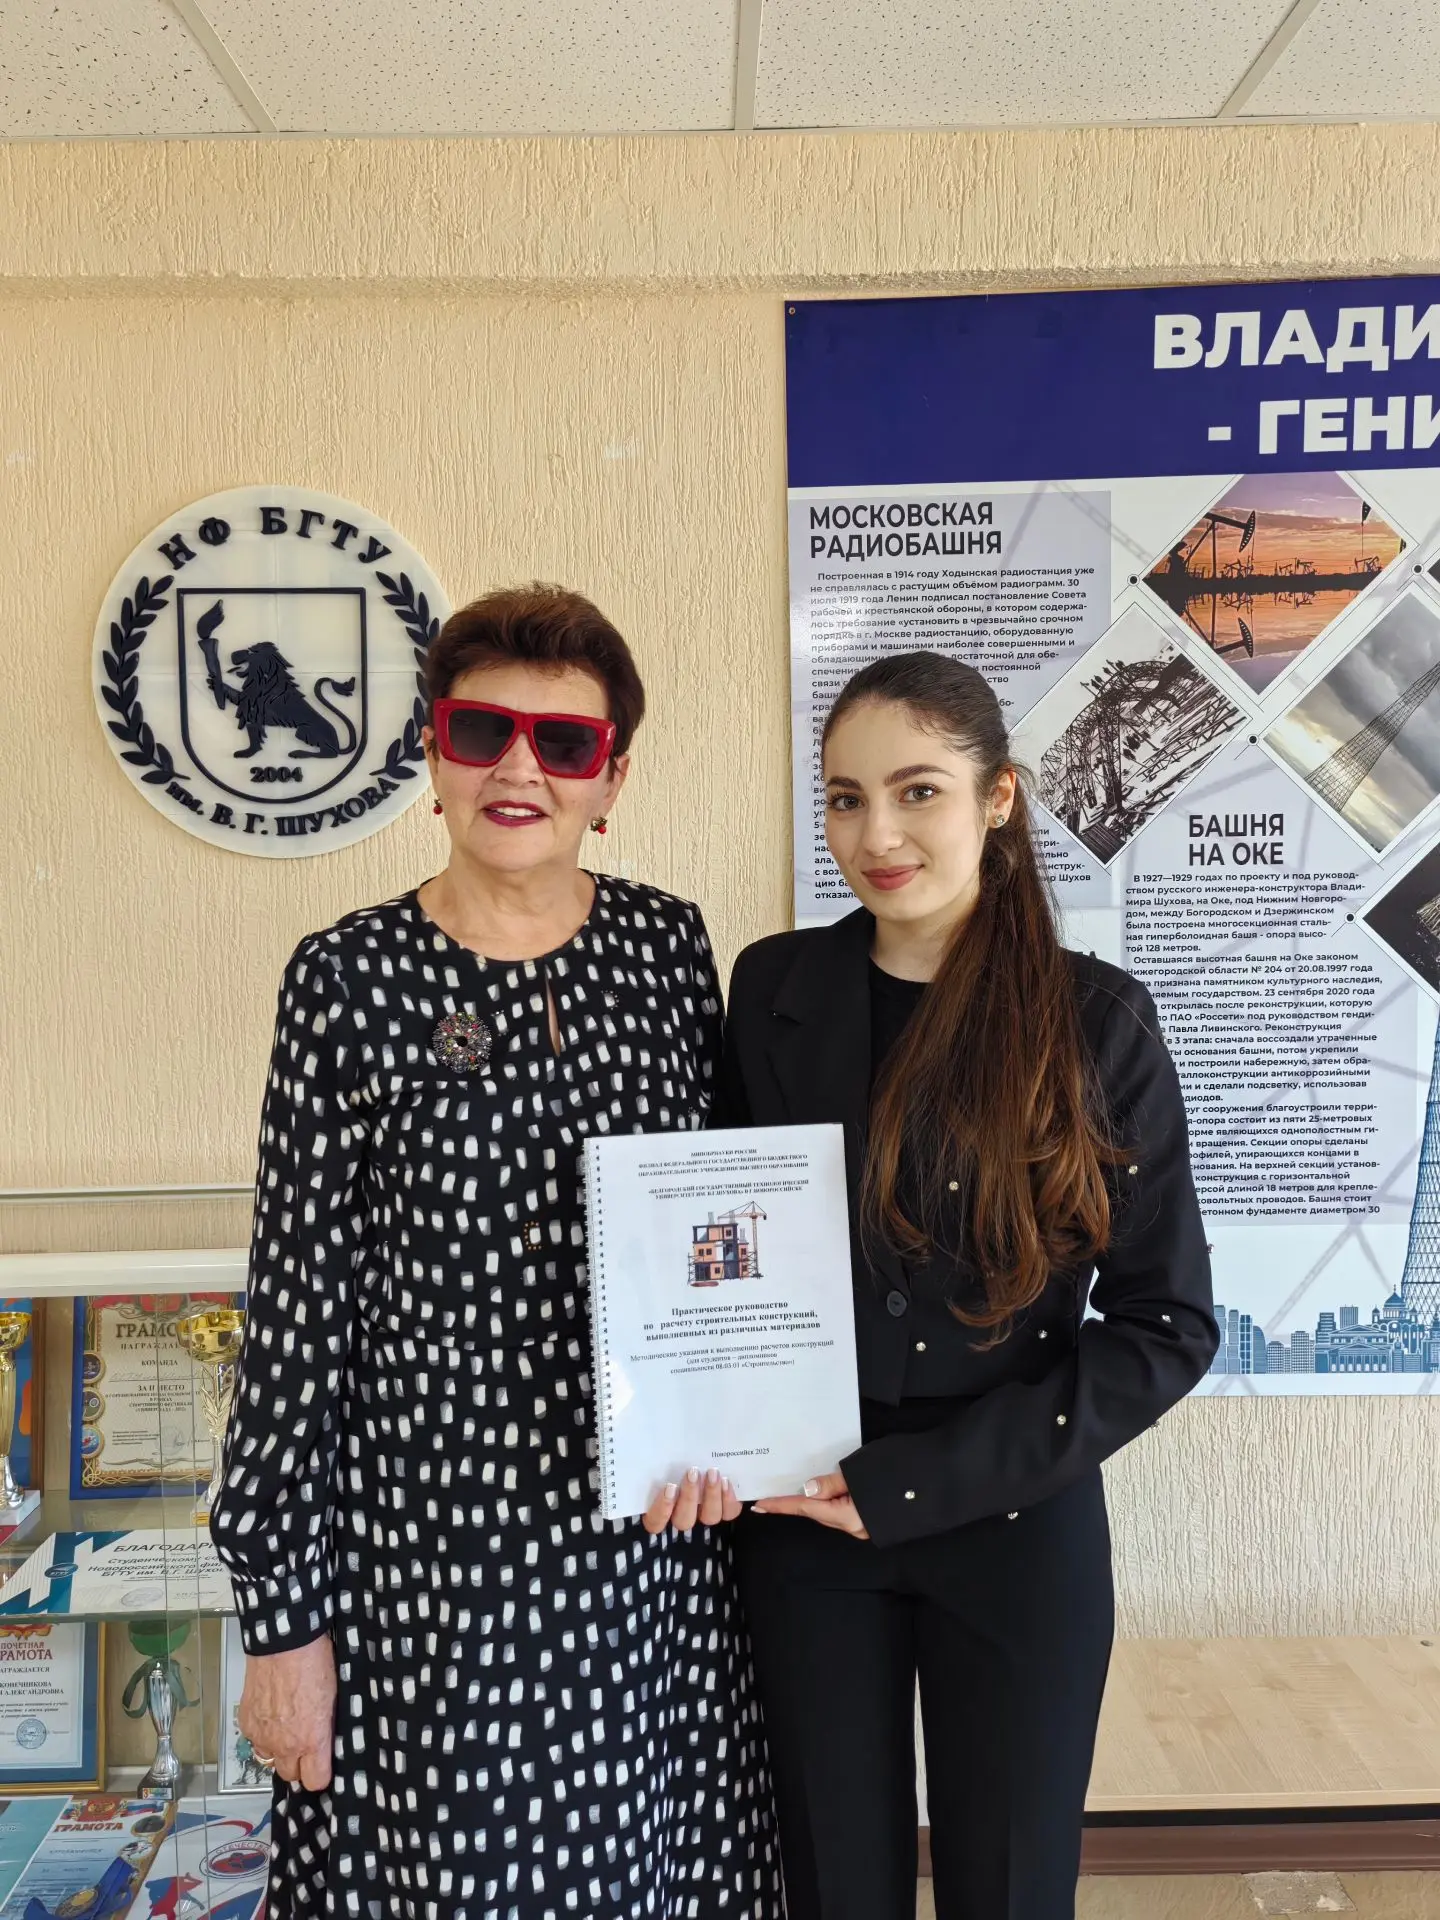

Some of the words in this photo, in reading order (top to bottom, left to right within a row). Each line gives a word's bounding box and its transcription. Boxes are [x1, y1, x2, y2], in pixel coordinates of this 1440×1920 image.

[1154, 304, 1440, 373] ВЛАДИ
[810, 502, 993, 530] МОСКОВСКАЯ
[158, 517, 231, 570] НФ
[260, 507, 392, 564] БГТУ
[811, 531, 1002, 562] РАДИОБАШНЯ
[818, 570, 883, 582] Построенная
[894, 570, 914, 578] 1914
[916, 571, 939, 579] году
[942, 568, 997, 578] Ходынская
[1000, 568, 1072, 577] радиостанция
[1074, 567, 1094, 576] уже
[824, 584, 889, 593] справлялась
[899, 582, 949, 592] растущим
[952, 579, 997, 588] объёмом
[1000, 580, 1064, 589] радиограмм.
[838, 594, 858, 603] 1919
[886, 593, 918, 602] Ленин
[921, 594, 969, 602] подписал
[1051, 590, 1086, 598] Совета
[811, 642, 868, 653] приборами
[937, 639, 984, 648] наиболее
[987, 639, 1065, 649] совершенными
[250, 766, 302, 783] 2004
[166, 782, 204, 816] им.
[210, 803, 236, 828] В.
[246, 814, 268, 835] Г.
[275, 777, 400, 836] ШУХОВА
[1189, 814, 1284, 838] БАШНЯ
[1189, 844, 1224, 866] НА
[1232, 842, 1284, 866] ОКЕ
[1059, 874, 1092, 882] Шухов
[1142, 873, 1192, 882] 1927—1929
[1240, 873, 1280, 882] проекту
[1313, 872, 1358, 880] руковод-
[1157, 886, 1202, 894] русского
[1204, 884, 1327, 894] инженера-конструктора
[1330, 882, 1365, 891] Влади-
[1126, 899, 1151, 907] мира
[1154, 896, 1194, 906] Шухова,
[1210, 896, 1232, 905] Оке,
[1256, 894, 1298, 903] Нижним
[1301, 894, 1346, 904] Новгоро-
[1150, 910, 1183, 918] между
[1186, 907, 1252, 917] Богородском
[1263, 906, 1334, 916] Дзержинском
[1126, 920, 1151, 928] была
[1154, 921, 1205, 930] построена
[1208, 920, 1297, 928] многосекционная
[1146, 931, 1228, 942] гиперболоидная
[1231, 930, 1257, 938] башя
[1266, 931, 1296, 940] опора
[1125, 944, 1142, 952] той
[1163, 944, 1200, 953] метров.
[1134, 955, 1192, 963] Оставшаяся
[1244, 953, 1276, 961] башня
[1294, 953, 1313, 961] Оке
[1127, 966, 1205, 977] Нижегородской
[1208, 965, 1248, 974] области
[1264, 964, 1282, 972] 204
[1297, 963, 1347, 972] 20.08.1997
[1169, 1024, 1198, 1032] Павла
[1200, 1023, 1262, 1032] Ливинского.
[1264, 1021, 1341, 1032] Реконструкция
[1196, 1140, 1248, 1148] вращения.
[1250, 1137, 1287, 1147] Секции
[1290, 1138, 1322, 1147] опоры
[1196, 1174, 1258, 1182] конструкция
[1269, 1171, 1350, 1181] горизонтальной
[672, 1305, 732, 1317] Практическое
[734, 1302, 788, 1312] руководство
[660, 1319, 692, 1329] расчету
[695, 1315, 756, 1326] строительных
[759, 1310, 817, 1321] конструкций,
[646, 1330, 705, 1340] выполненных
[720, 1325, 767, 1336] различных
[770, 1322, 820, 1332] материалов
[711, 1449, 753, 1458] Новороссийск
[0, 1649, 53, 1660] РАМОТА
[54, 1822, 124, 1832] ГРАМОТА
